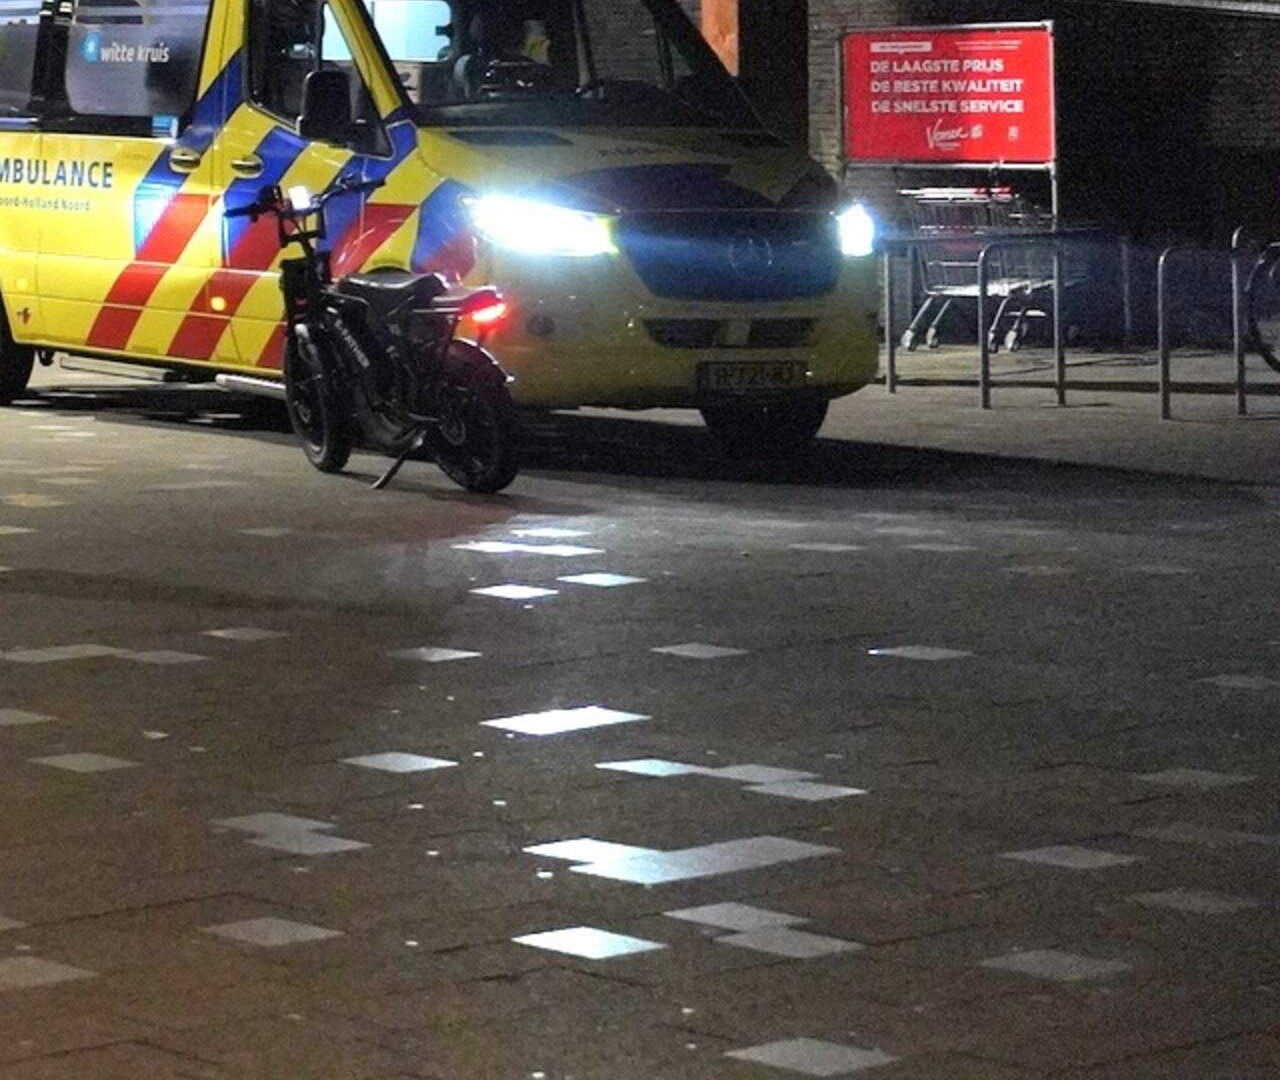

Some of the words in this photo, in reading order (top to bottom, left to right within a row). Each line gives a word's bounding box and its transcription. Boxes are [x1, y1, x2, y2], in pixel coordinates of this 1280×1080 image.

[100, 41, 135, 62] witte
[137, 41, 170, 63] kruis
[870, 61, 890, 73] DE
[893, 60, 959, 73] LAAGSTE
[962, 58, 1004, 73] PRIJS
[871, 80, 890, 93] DE
[893, 80, 939, 93] BESTE
[942, 79, 1024, 93] KWALITEIT
[871, 100, 891, 113] DE
[893, 100, 958, 113] SNELSTE
[961, 100, 1024, 113] SERVICE
[61, 195, 91, 211] Noord
